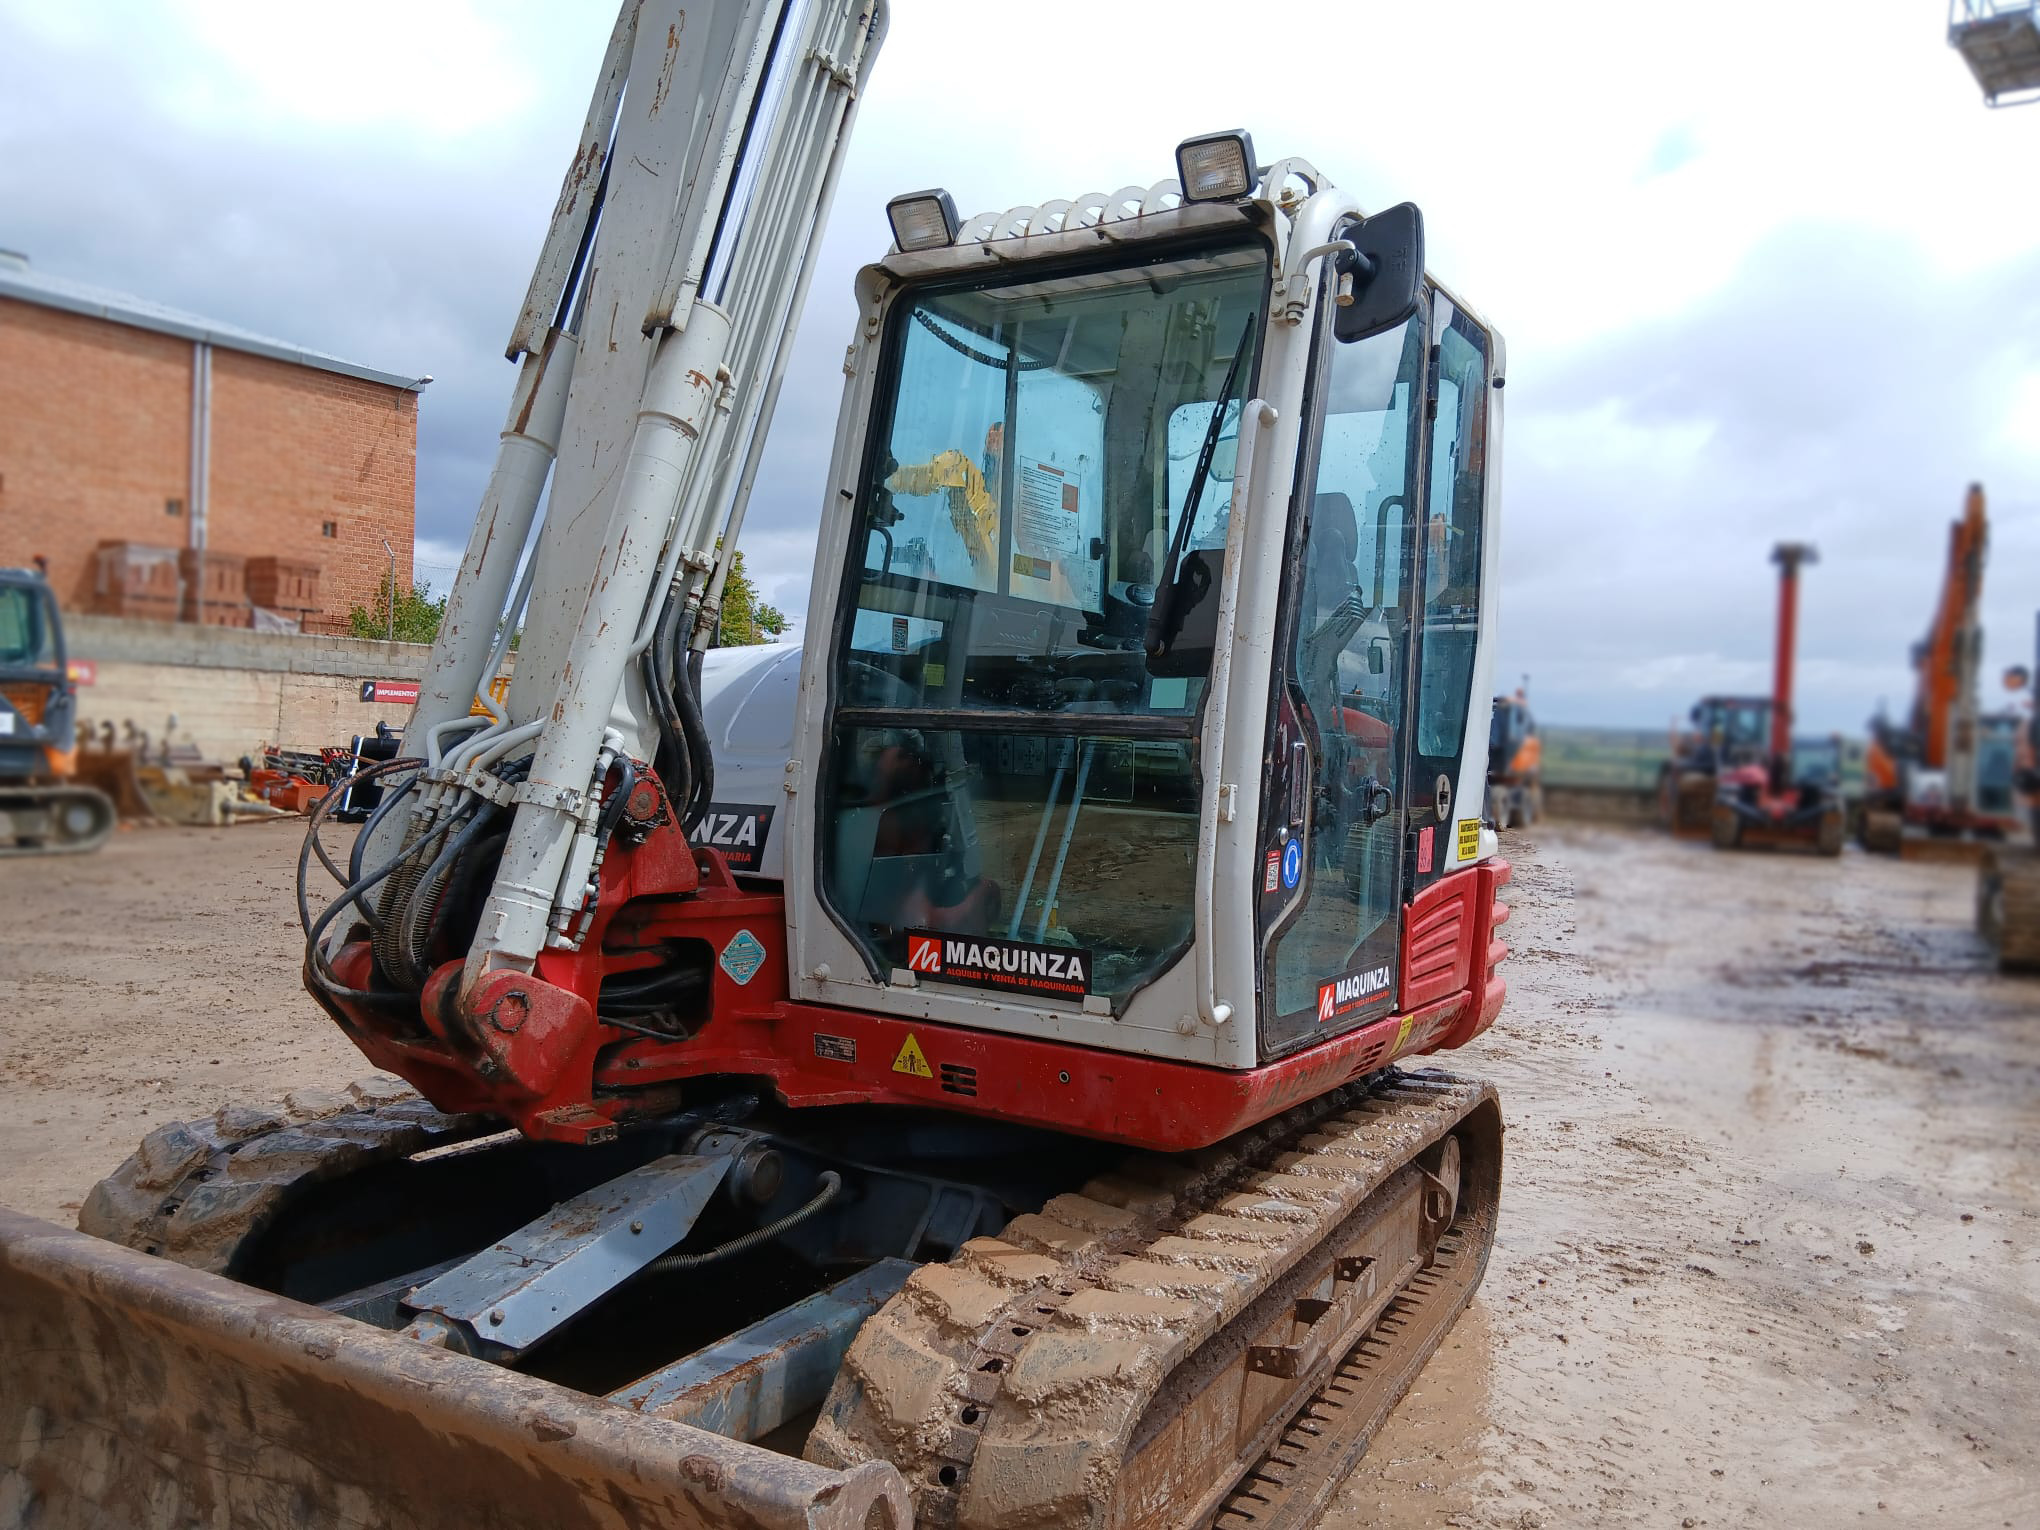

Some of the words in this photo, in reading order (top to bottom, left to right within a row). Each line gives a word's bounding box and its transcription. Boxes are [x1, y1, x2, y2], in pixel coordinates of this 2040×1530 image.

[690, 813, 756, 847] NZA
[946, 940, 1085, 982] MAQUINZA
[946, 967, 982, 980] ALQUILER
[983, 973, 989, 981] Y
[991, 974, 1017, 985] VENTA
[1018, 976, 1028, 986] DE
[1030, 979, 1085, 994] MAQUINARIA
[1336, 966, 1390, 1004] MAQUINZA
